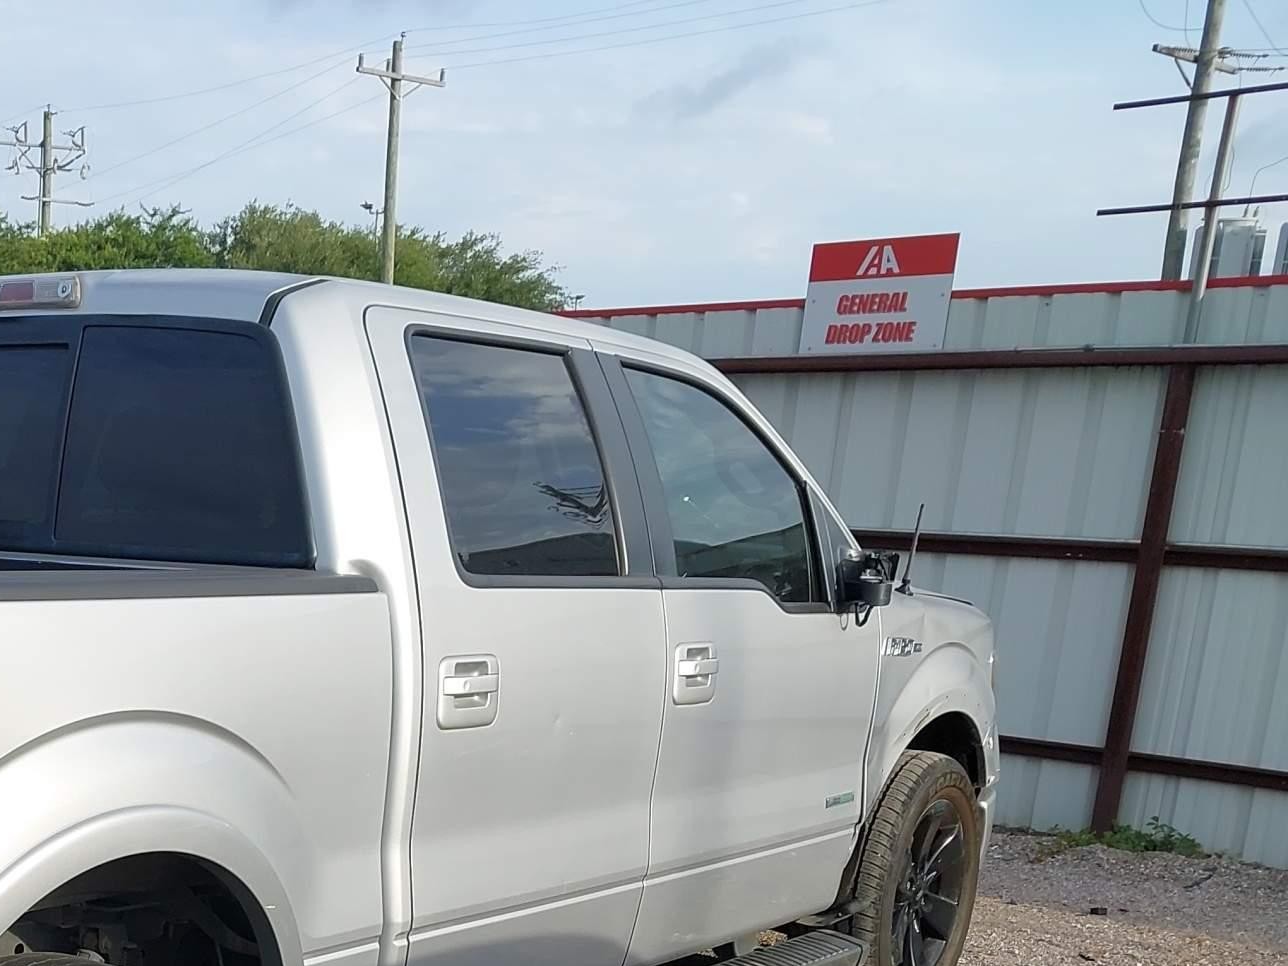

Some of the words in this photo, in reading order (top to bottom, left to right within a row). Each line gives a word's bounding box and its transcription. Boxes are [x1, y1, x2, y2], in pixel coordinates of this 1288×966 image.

[836, 291, 908, 315] GENERAL
[824, 322, 872, 345] DROP
[872, 320, 917, 343] ZONE
